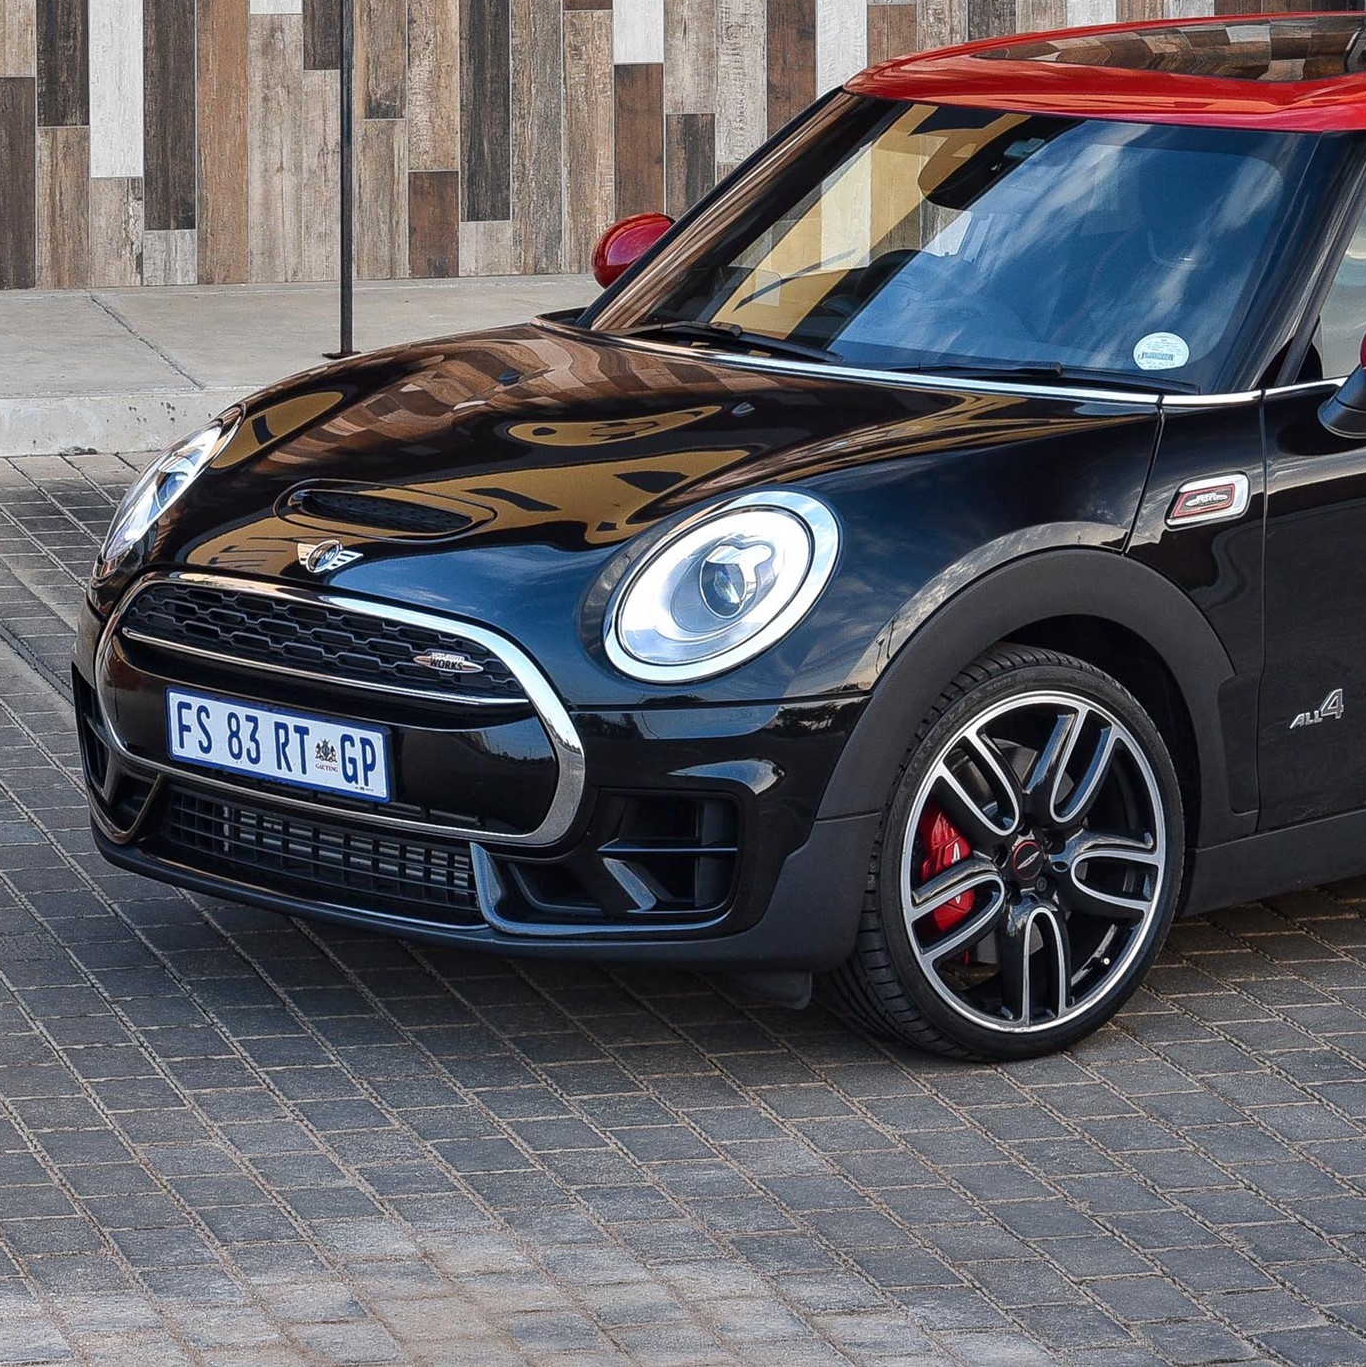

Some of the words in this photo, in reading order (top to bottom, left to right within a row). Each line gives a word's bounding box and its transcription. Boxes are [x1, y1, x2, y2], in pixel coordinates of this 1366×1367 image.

[430, 659, 463, 670] WORKS
[176, 700, 212, 754] FS
[227, 712, 261, 765] 83
[274, 720, 310, 775] RT
[340, 733, 376, 787] GP
